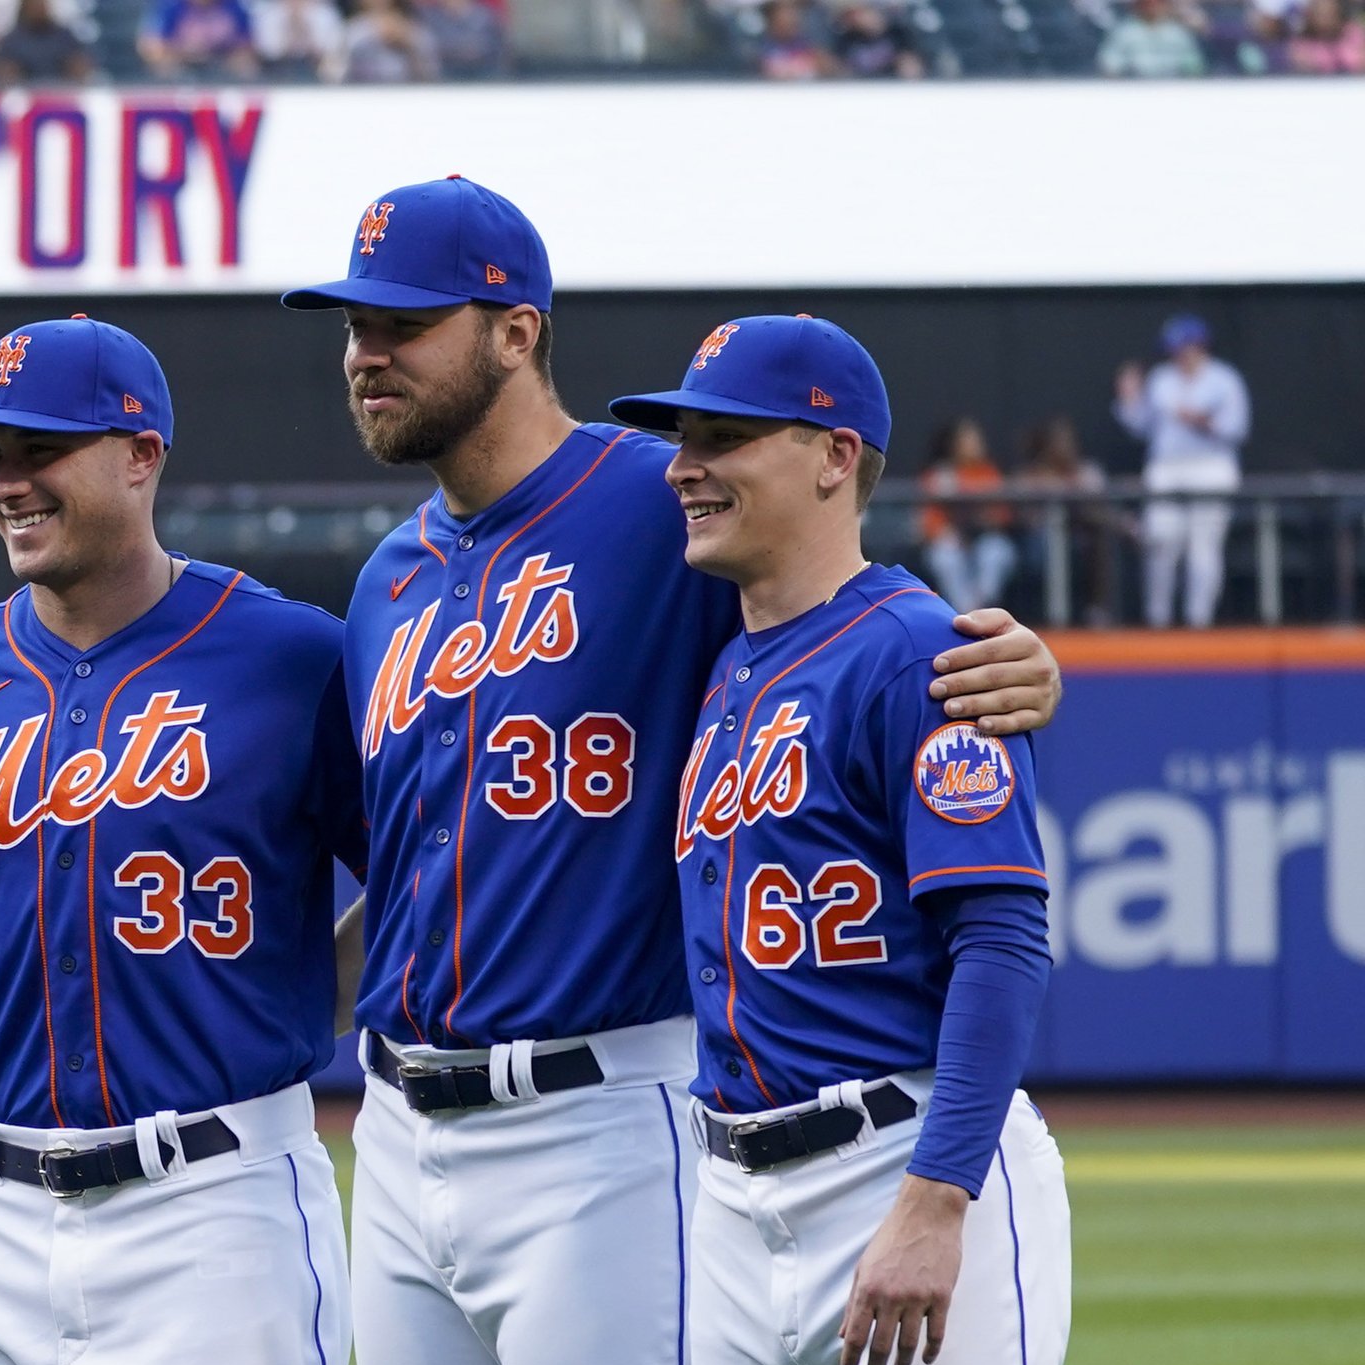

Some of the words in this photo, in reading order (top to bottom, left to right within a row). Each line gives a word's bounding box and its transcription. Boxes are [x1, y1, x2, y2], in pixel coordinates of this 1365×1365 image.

[361, 552, 579, 760] Mets
[484, 711, 636, 821] 38
[932, 759, 998, 797] Mets
[113, 851, 255, 960] 33
[740, 859, 888, 970] 62
